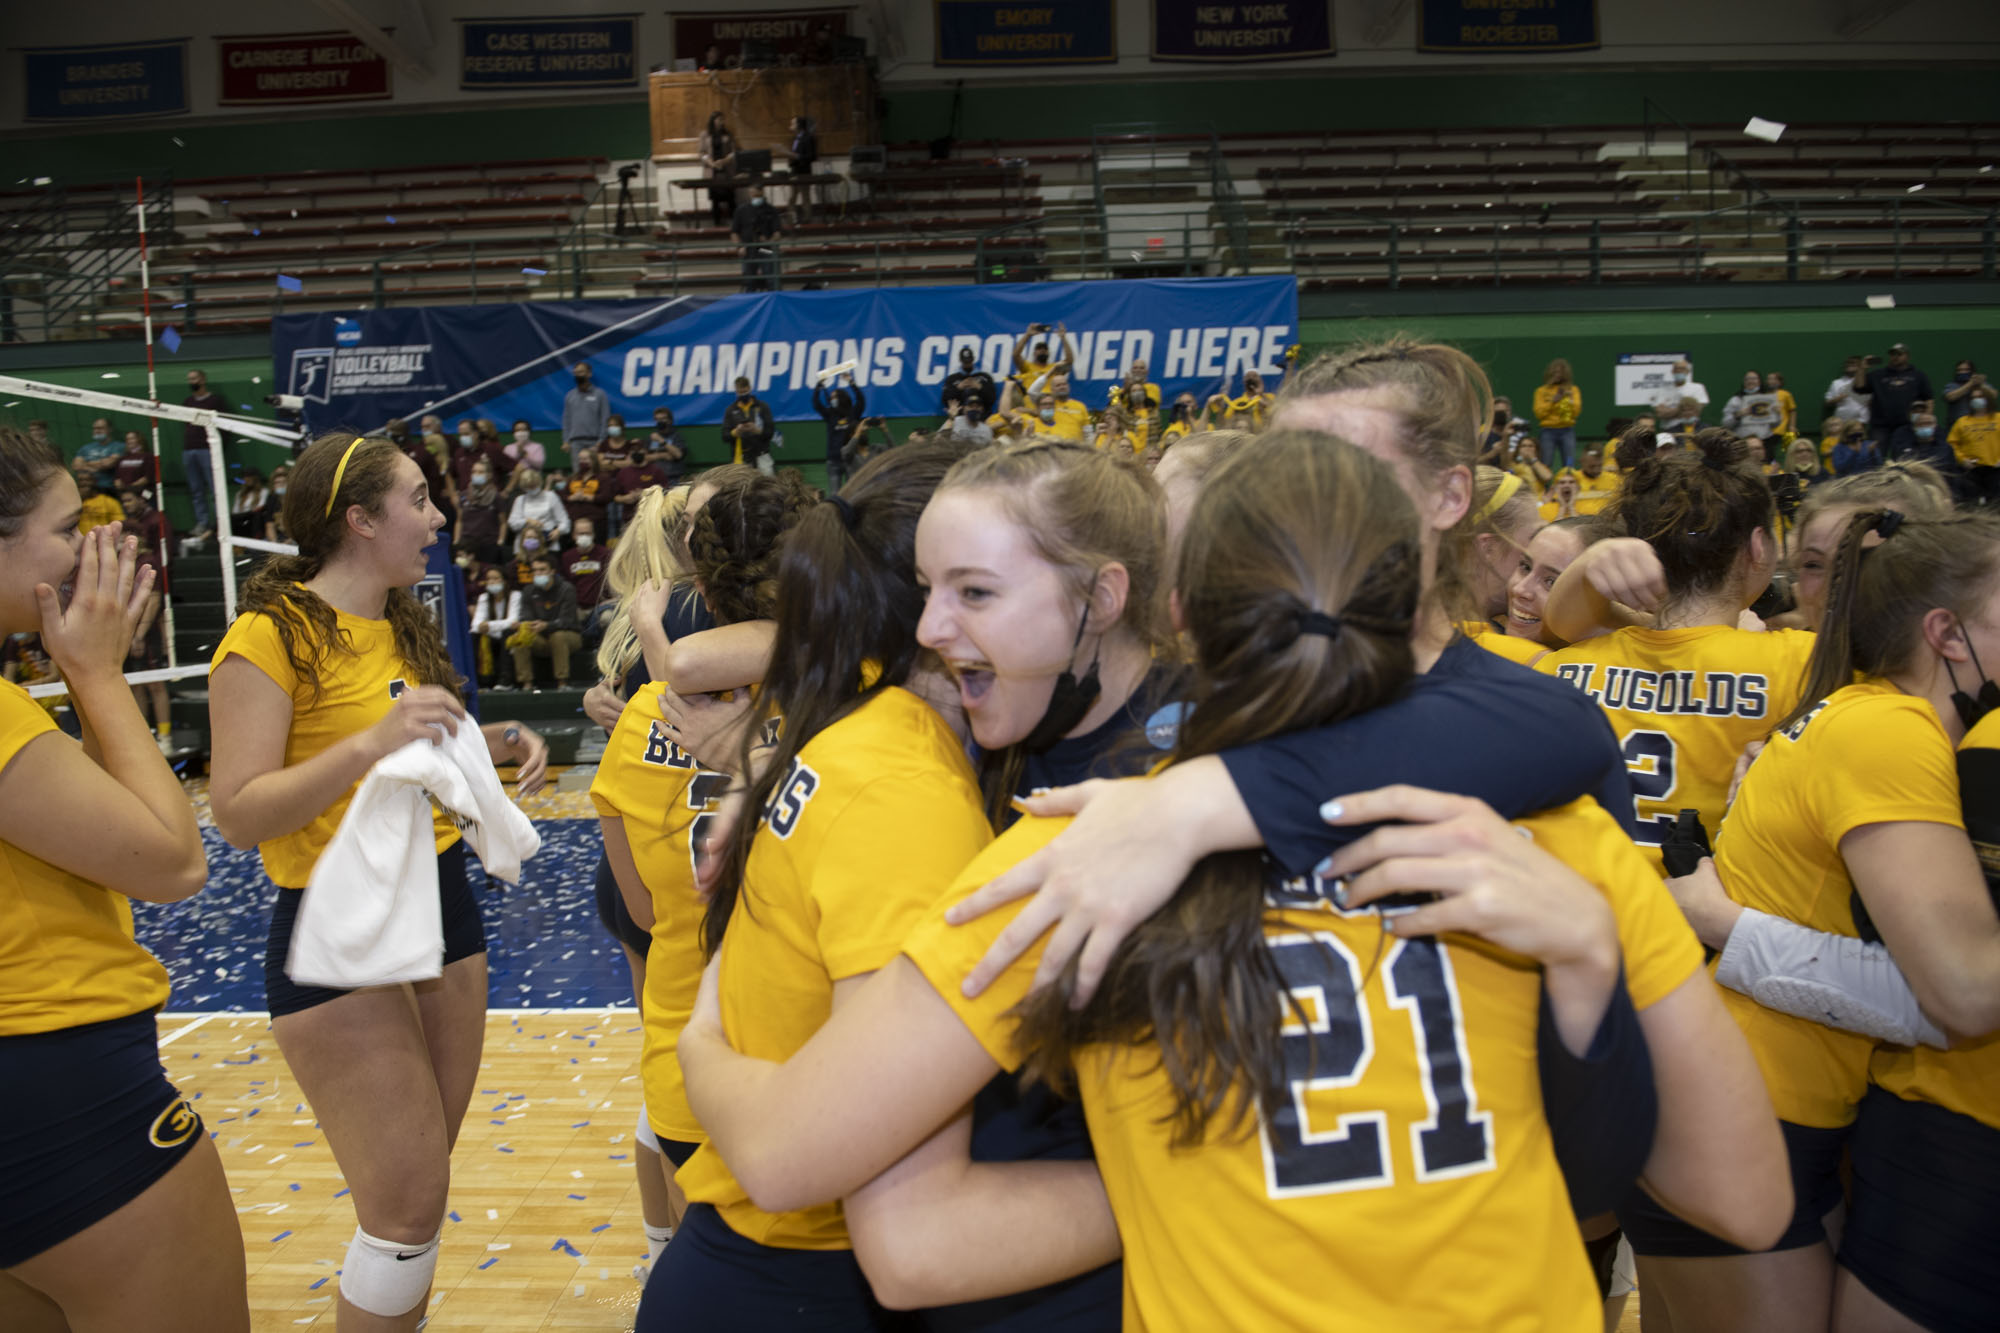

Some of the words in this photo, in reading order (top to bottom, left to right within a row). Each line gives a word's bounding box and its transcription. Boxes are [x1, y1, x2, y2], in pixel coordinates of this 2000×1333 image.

[995, 9, 1054, 26] EMORY
[1197, 6, 1233, 24] NEW
[1242, 4, 1287, 22] YORK
[712, 20, 809, 39] UNIVERSITY
[1194, 27, 1293, 46] UNIVERSITY
[1461, 24, 1559, 42] ROCHESTER
[486, 33, 529, 51] CASE
[533, 32, 611, 50] WESTERN
[976, 33, 1075, 51] UNIVERSITY
[229, 49, 308, 69] CARNEGIE
[464, 56, 536, 72] RESERVE
[540, 53, 634, 71] UNIVERSITY
[66, 61, 145, 82] BRANDEIS
[257, 70, 350, 90] UNIVERSITY
[59, 84, 150, 104] UNIVERSITY
[334, 353, 425, 375] VOLLEYBALL
[621, 336, 905, 398] CHAMPIONS
[1164, 325, 1290, 380] HERE
[333, 373, 413, 387] CHAMPIONSHIP
[1619, 728, 1678, 848] 2
[1257, 930, 1497, 1199] 21
